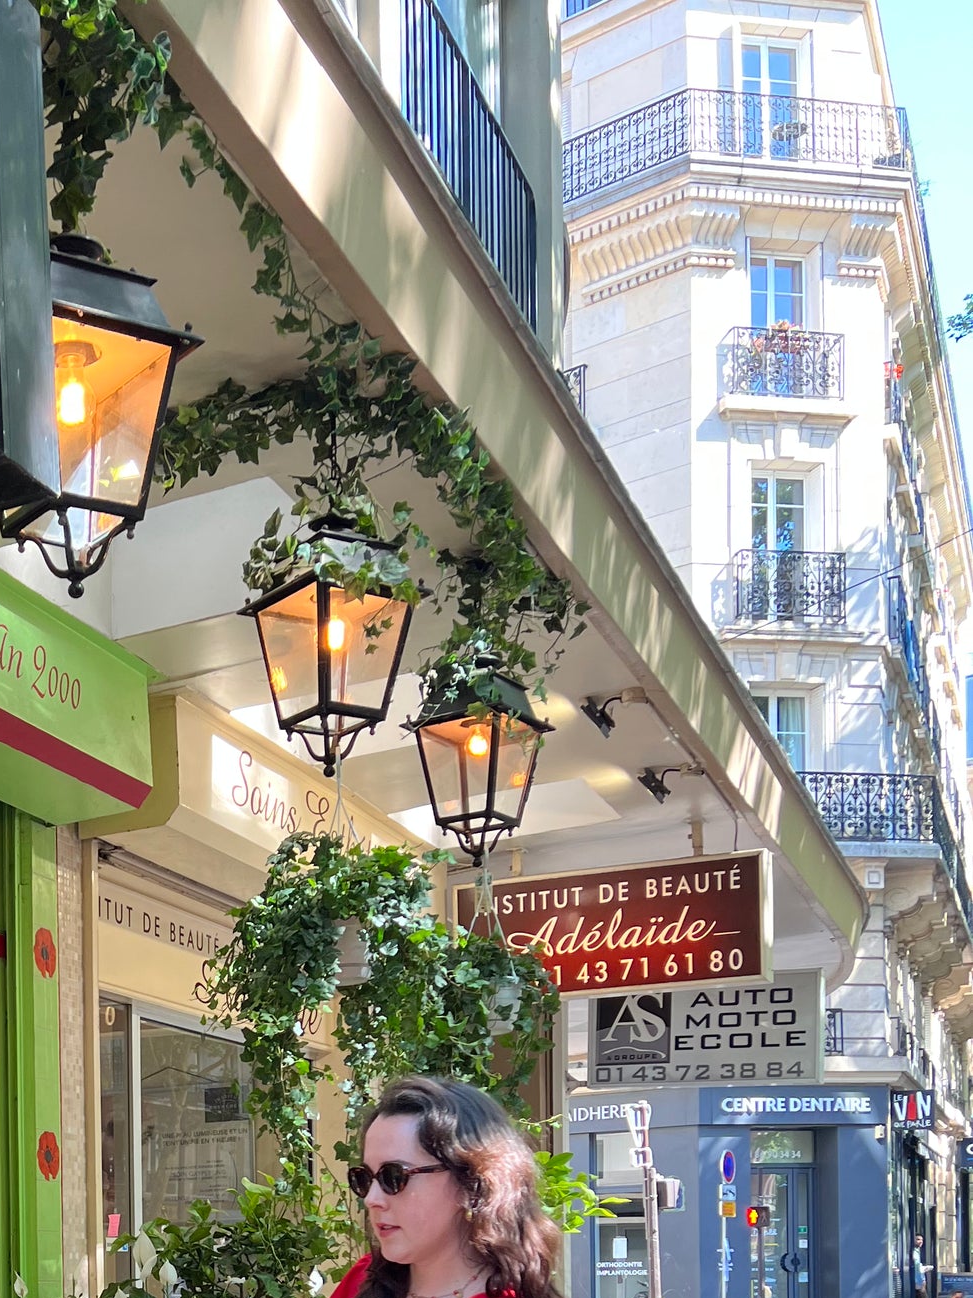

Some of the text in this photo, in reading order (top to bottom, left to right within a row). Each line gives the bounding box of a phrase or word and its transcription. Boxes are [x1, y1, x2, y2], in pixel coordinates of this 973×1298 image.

[31, 645, 81, 710] 2000
[231, 750, 302, 834] Soins
[599, 881, 629, 904] DE
[645, 864, 741, 899] BEAUTÉ
[142, 912, 161, 938] DE
[506, 905, 717, 958] Adélaïde
[576, 960, 608, 984] 43
[619, 957, 649, 981] 71
[664, 953, 694, 977] 61
[709, 948, 744, 973] 80
[690, 987, 794, 1008] AUTO
[600, 991, 666, 1044] AS
[685, 1009, 797, 1030] MOTO
[674, 1030, 807, 1051] ECOLE
[720, 1096, 872, 1114] CENTRE DENTAIRE
